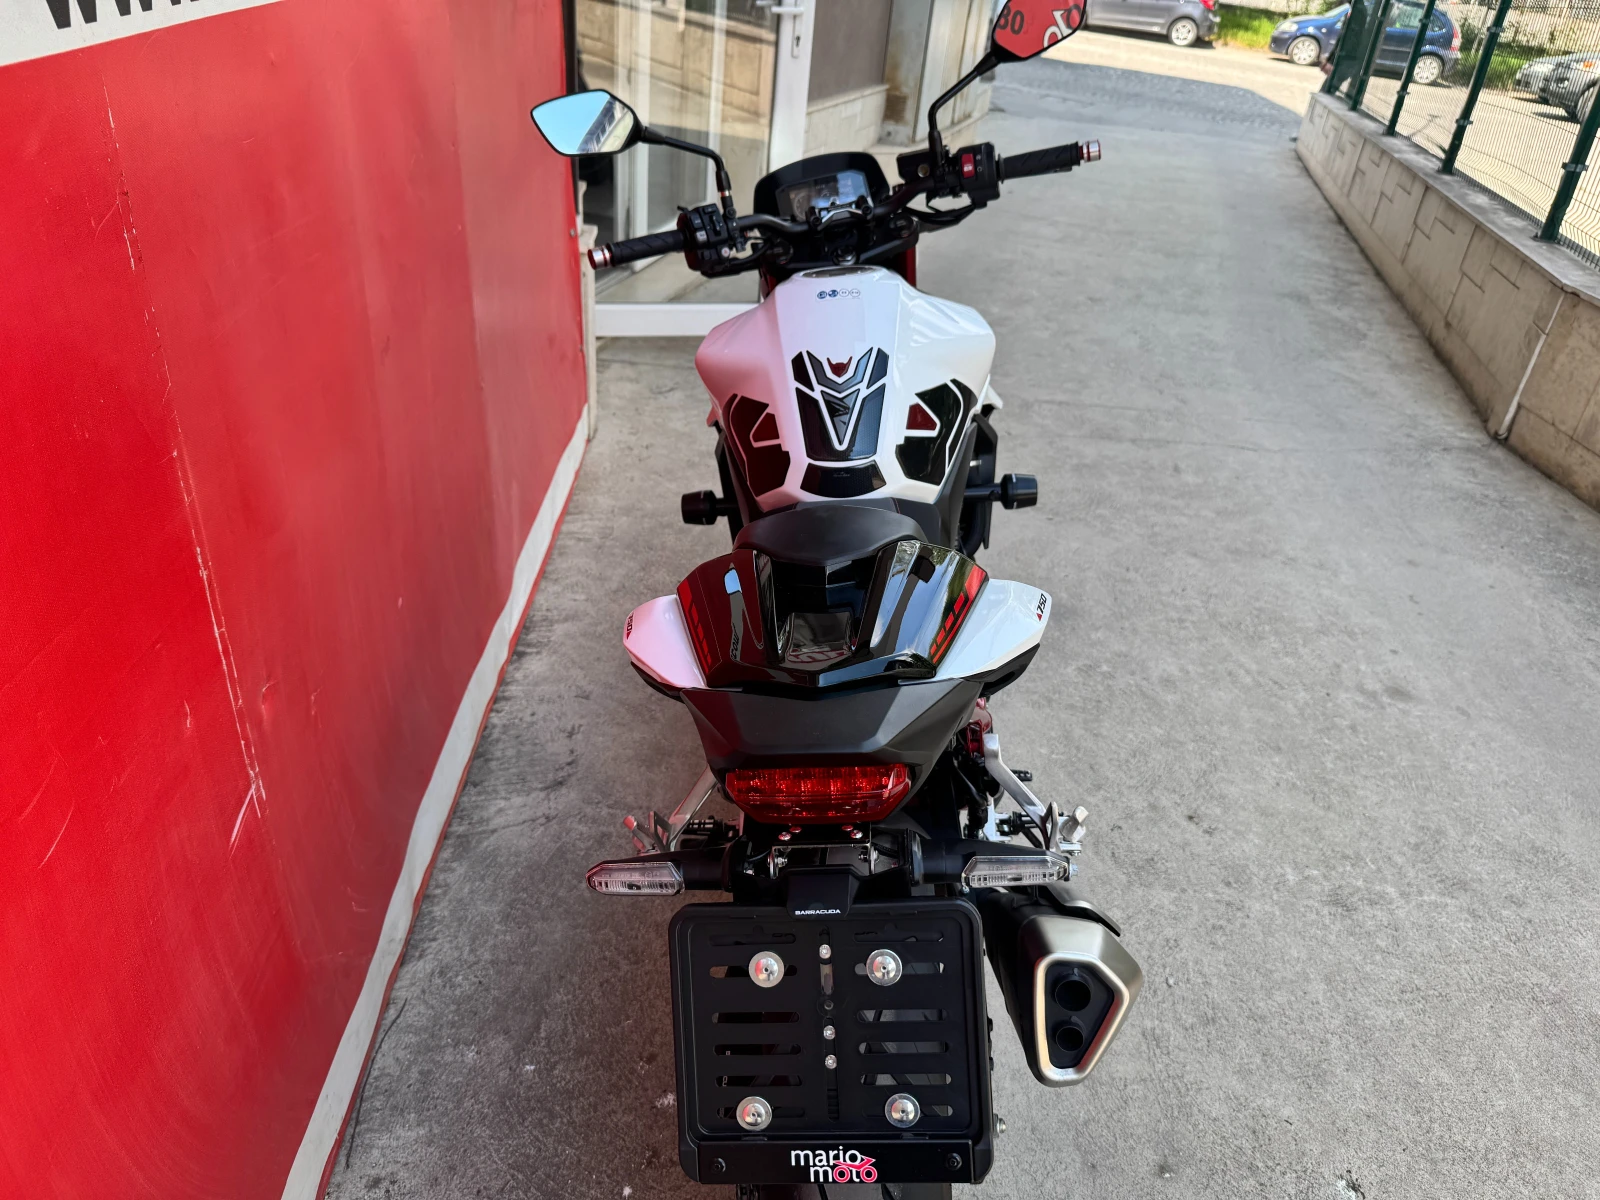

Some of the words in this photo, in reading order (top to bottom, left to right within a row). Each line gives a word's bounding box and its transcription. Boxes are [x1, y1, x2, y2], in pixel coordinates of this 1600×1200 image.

[1036, 593, 1047, 614] 750
[795, 908, 841, 916] BARRACUDA
[791, 1146, 861, 1166] mario
[809, 1165, 878, 1183] moto
